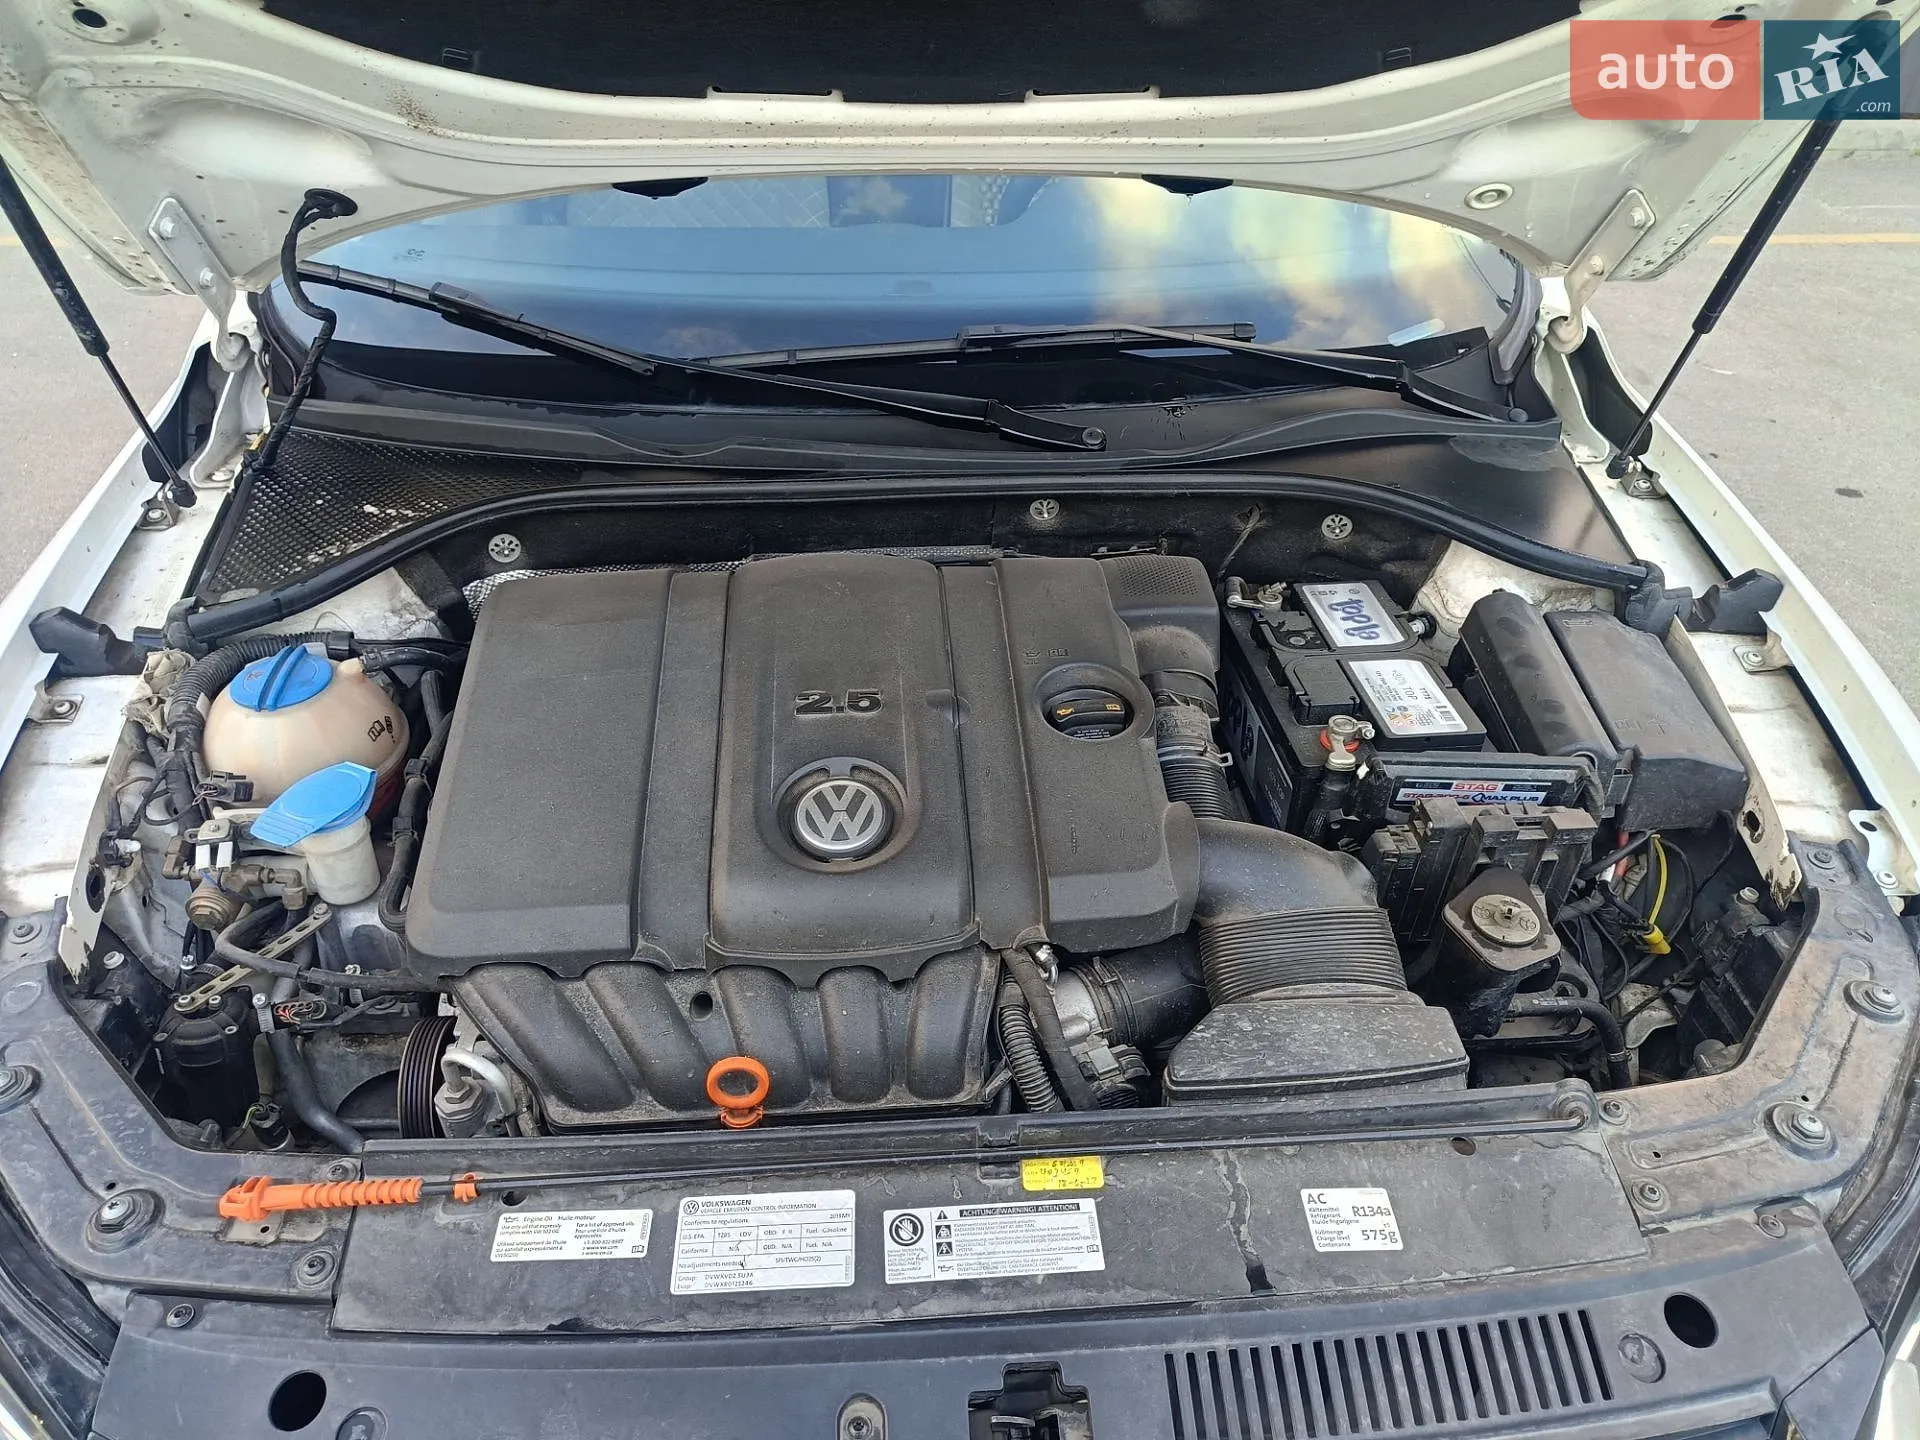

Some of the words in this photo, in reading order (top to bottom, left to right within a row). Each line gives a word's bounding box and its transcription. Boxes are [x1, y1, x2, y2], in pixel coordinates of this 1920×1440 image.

[795, 689, 882, 716] 2.5
[1453, 783, 1499, 791] STAG
[702, 1199, 751, 1207] VOLKSWAGEN
[1307, 1193, 1327, 1205] AC
[1352, 1205, 1392, 1217] R134a
